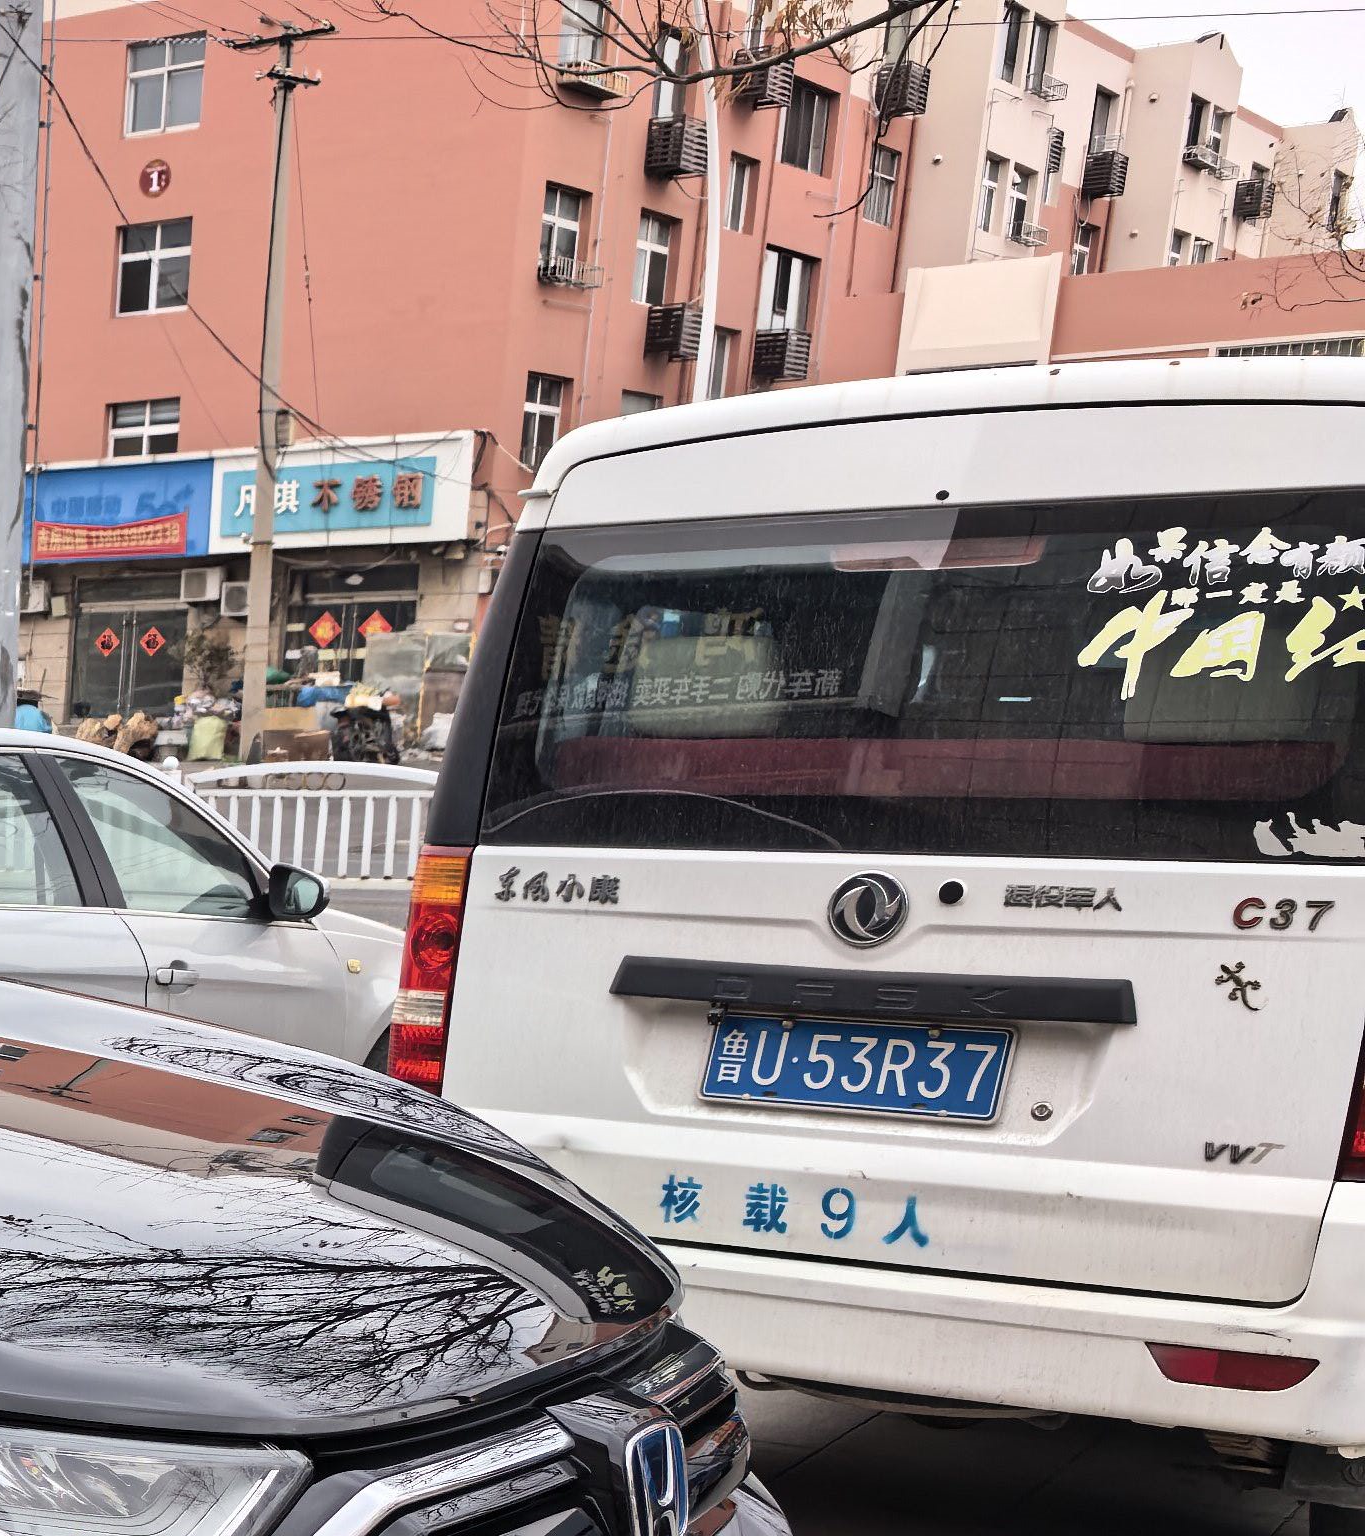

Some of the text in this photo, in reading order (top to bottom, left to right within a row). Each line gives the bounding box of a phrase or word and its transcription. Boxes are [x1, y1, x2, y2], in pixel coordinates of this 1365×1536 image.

[494, 866, 621, 905] 东风小康
[1003, 884, 1123, 912] 退役军人
[1232, 897, 1336, 932] C37
[710, 975, 1011, 1017] DFSK
[1204, 1141, 1286, 1165] VVT
[658, 1174, 932, 1248] 核载9人
